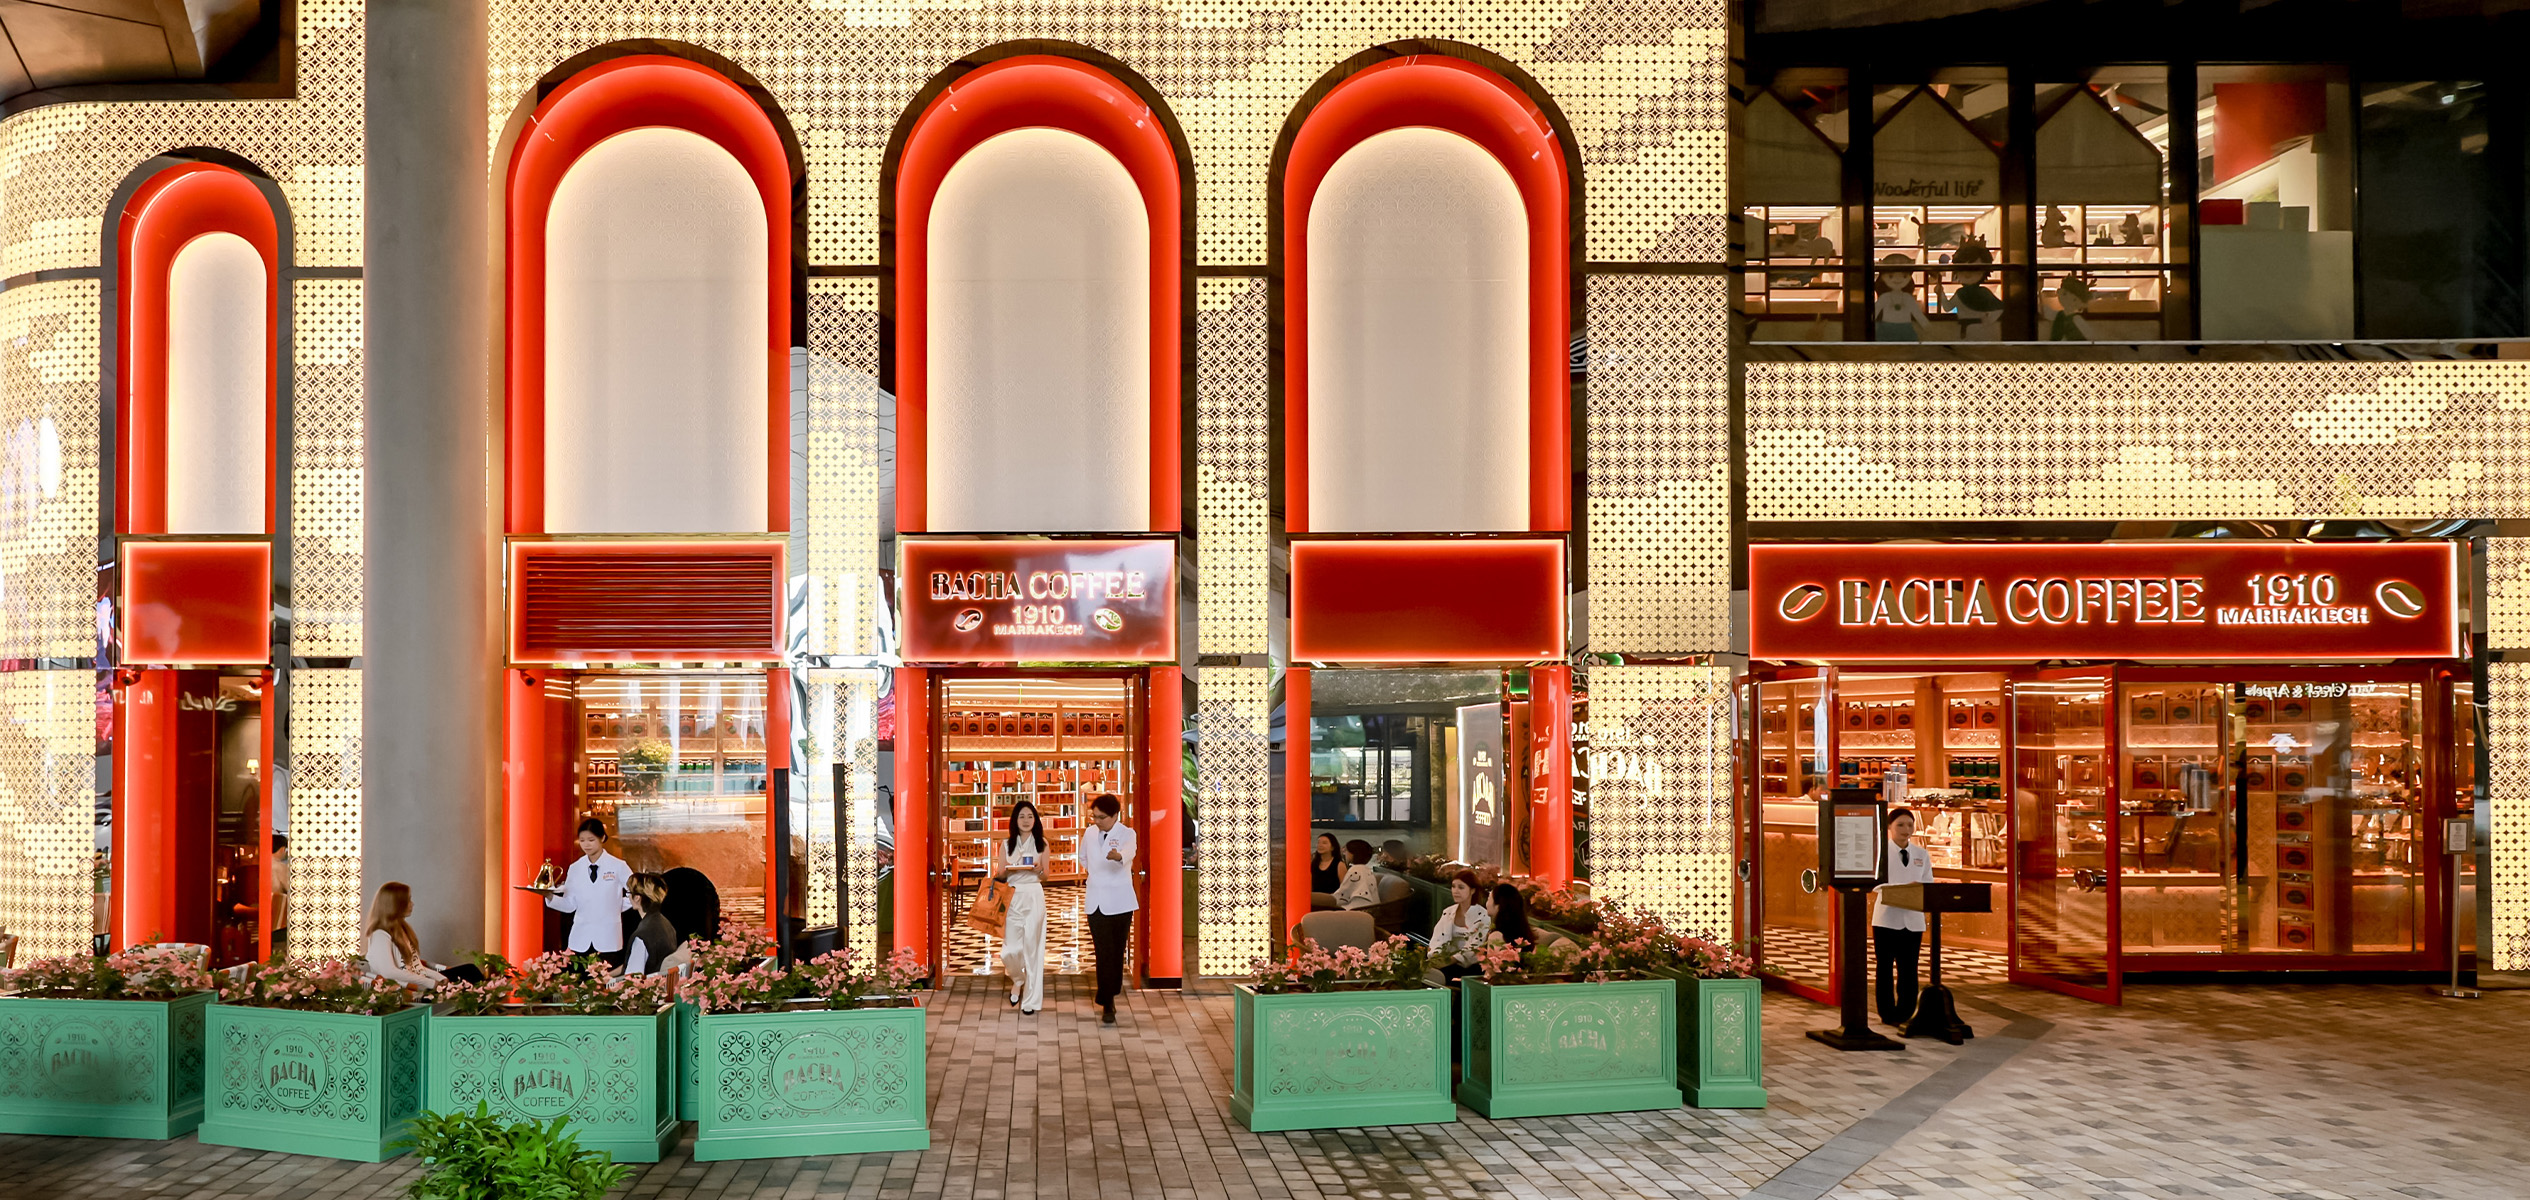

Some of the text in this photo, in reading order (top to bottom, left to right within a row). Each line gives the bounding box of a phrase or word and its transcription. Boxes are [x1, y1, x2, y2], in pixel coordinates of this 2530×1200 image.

[1954, 180, 1980, 198] life
[931, 572, 1145, 600] BACHA COFFEE
[2247, 574, 2336, 607] 1910
[1839, 577, 2206, 626] BACHA COFFEE
[1012, 605, 1065, 625] 1910
[2217, 606, 2370, 625] MARRAKECH
[994, 624, 1083, 636] MARRAKECH
[1574, 1015, 1593, 1023] 1910
[68, 1033, 87, 1041] 1910
[285, 1045, 303, 1054] 1910
[533, 1053, 556, 1061] 1910
[270, 1060, 317, 1093] BACHA
[514, 1068, 574, 1100] BACHA
[784, 1063, 844, 1094] BACHA
[277, 1087, 310, 1099] COFFEE
[523, 1097, 566, 1107] COFFEE
